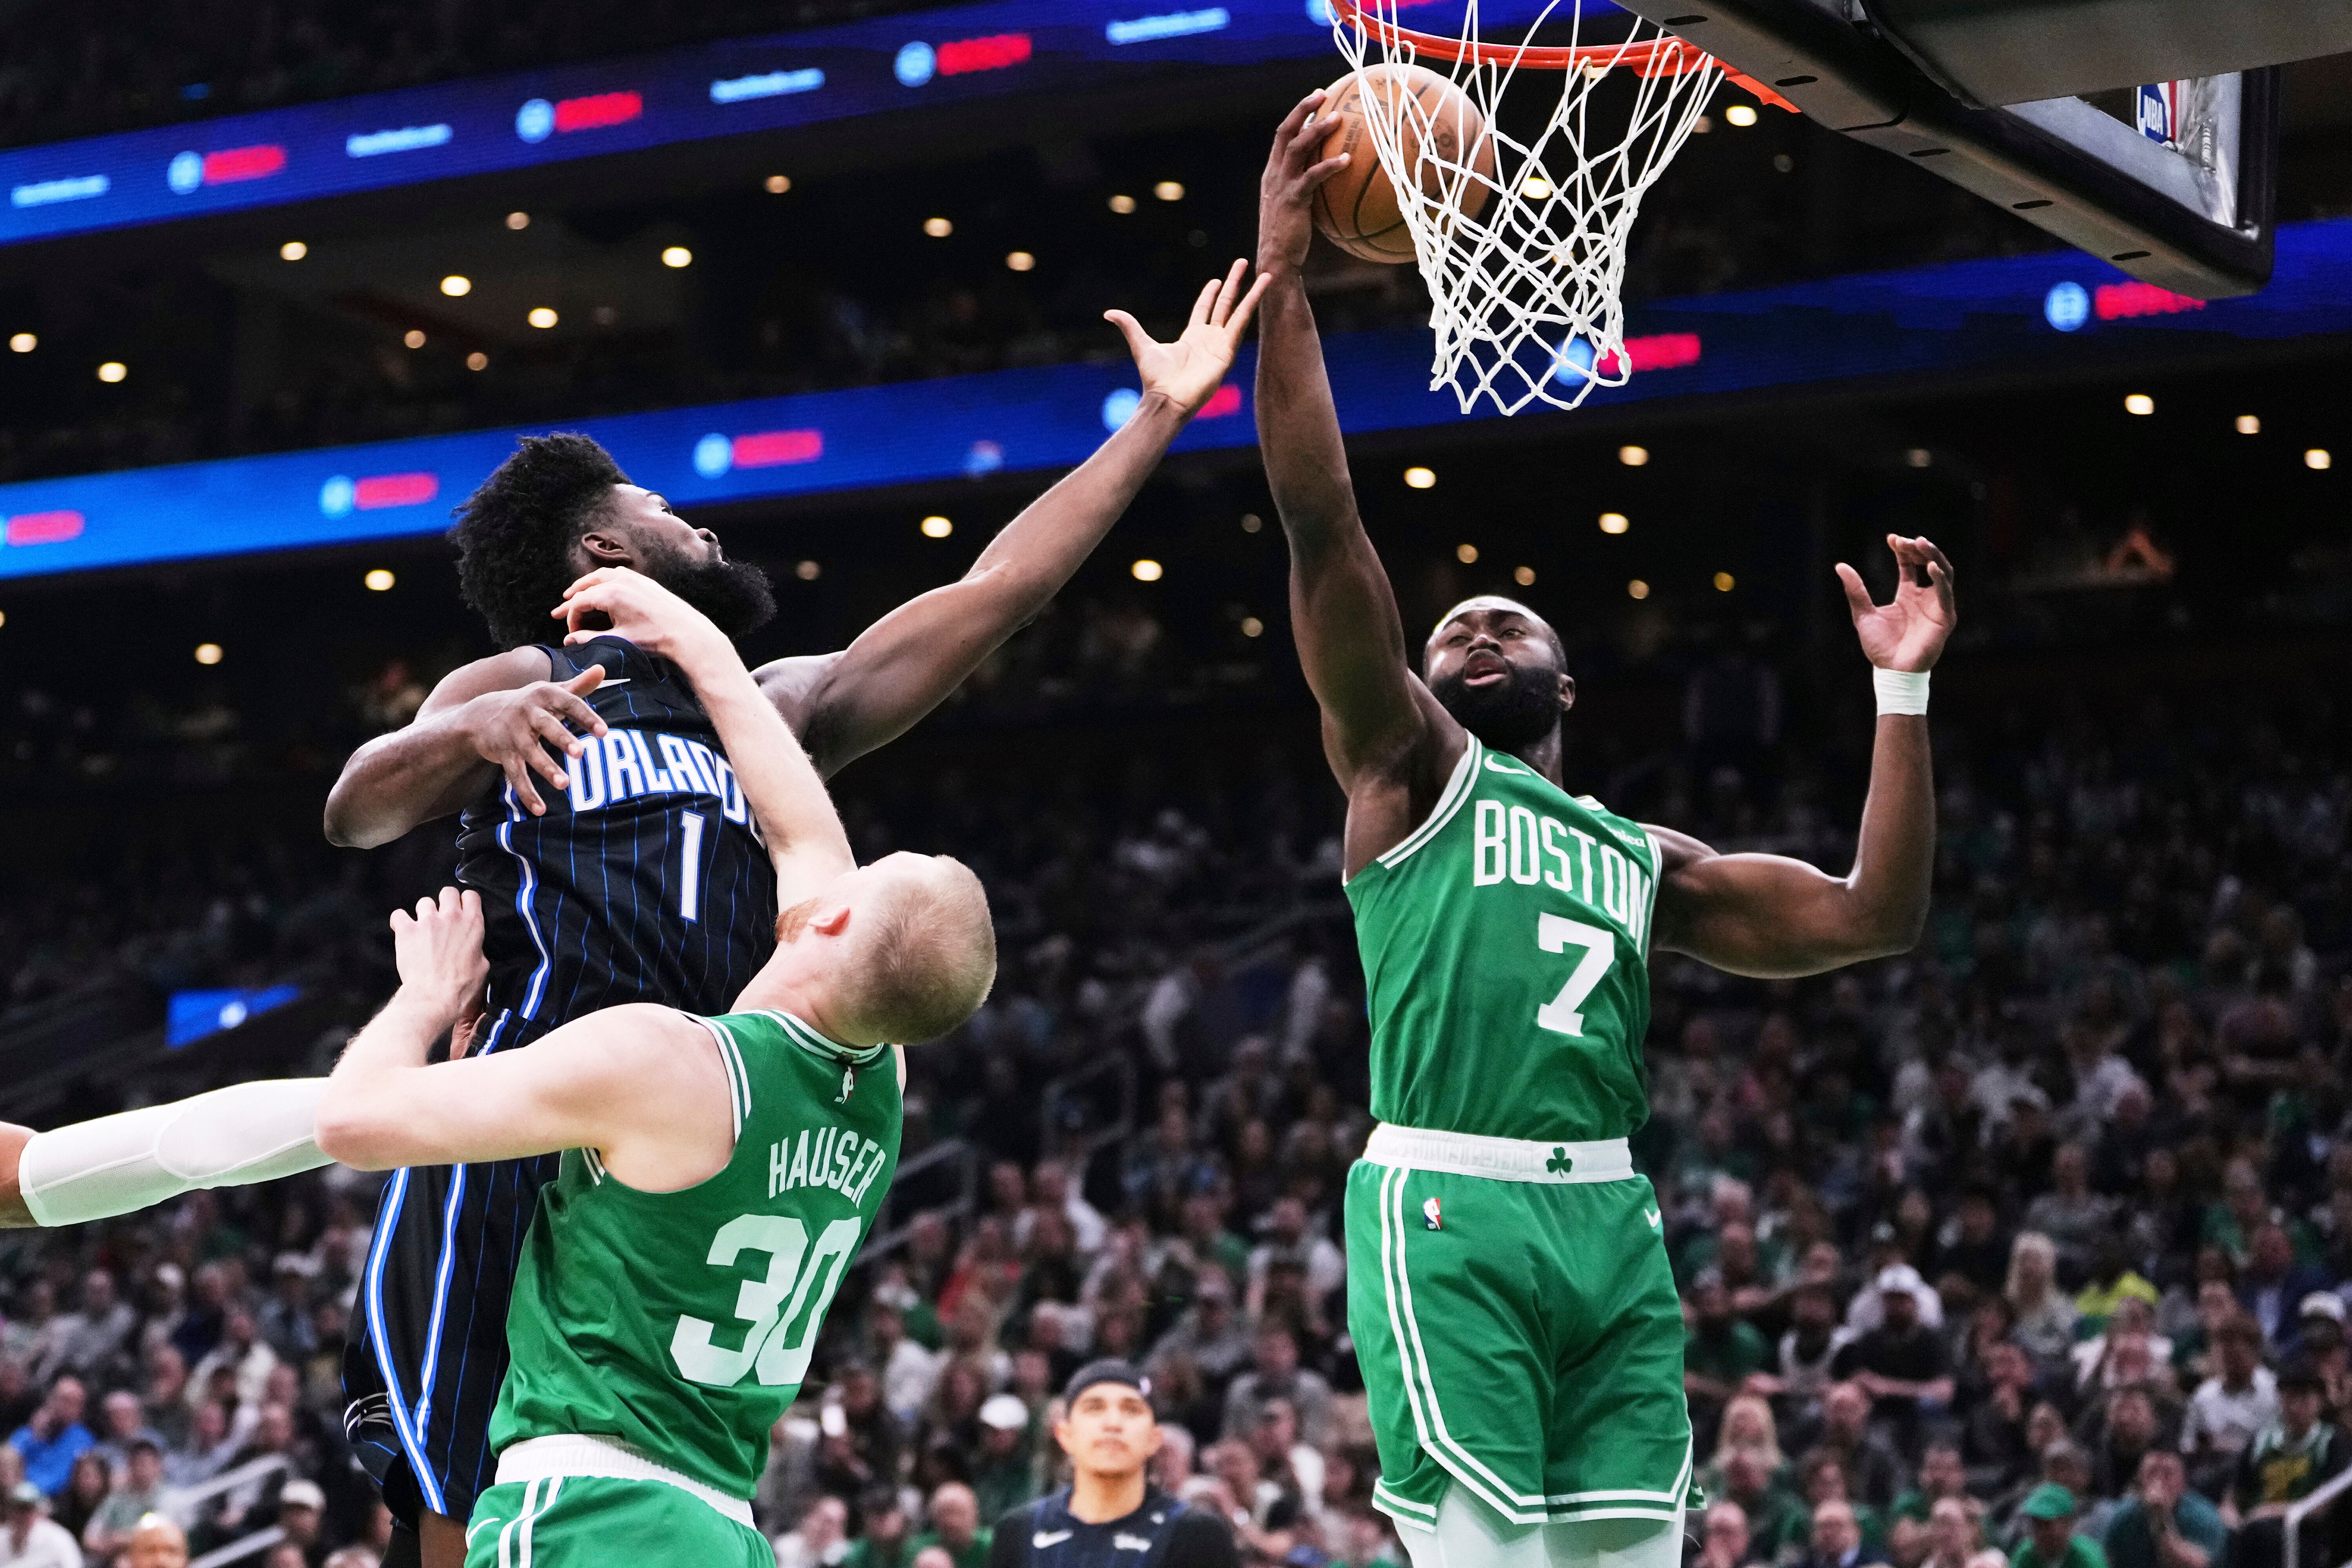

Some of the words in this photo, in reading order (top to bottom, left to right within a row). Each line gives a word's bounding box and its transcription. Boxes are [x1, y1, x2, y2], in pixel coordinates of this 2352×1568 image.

[2143, 94, 2163, 135] NBA
[679, 808, 706, 923] 1
[1473, 799, 1651, 955] BOSTON
[1538, 912, 1615, 1037] 7
[768, 1126, 886, 1208] HAUSER
[670, 1214, 861, 1387] 30
